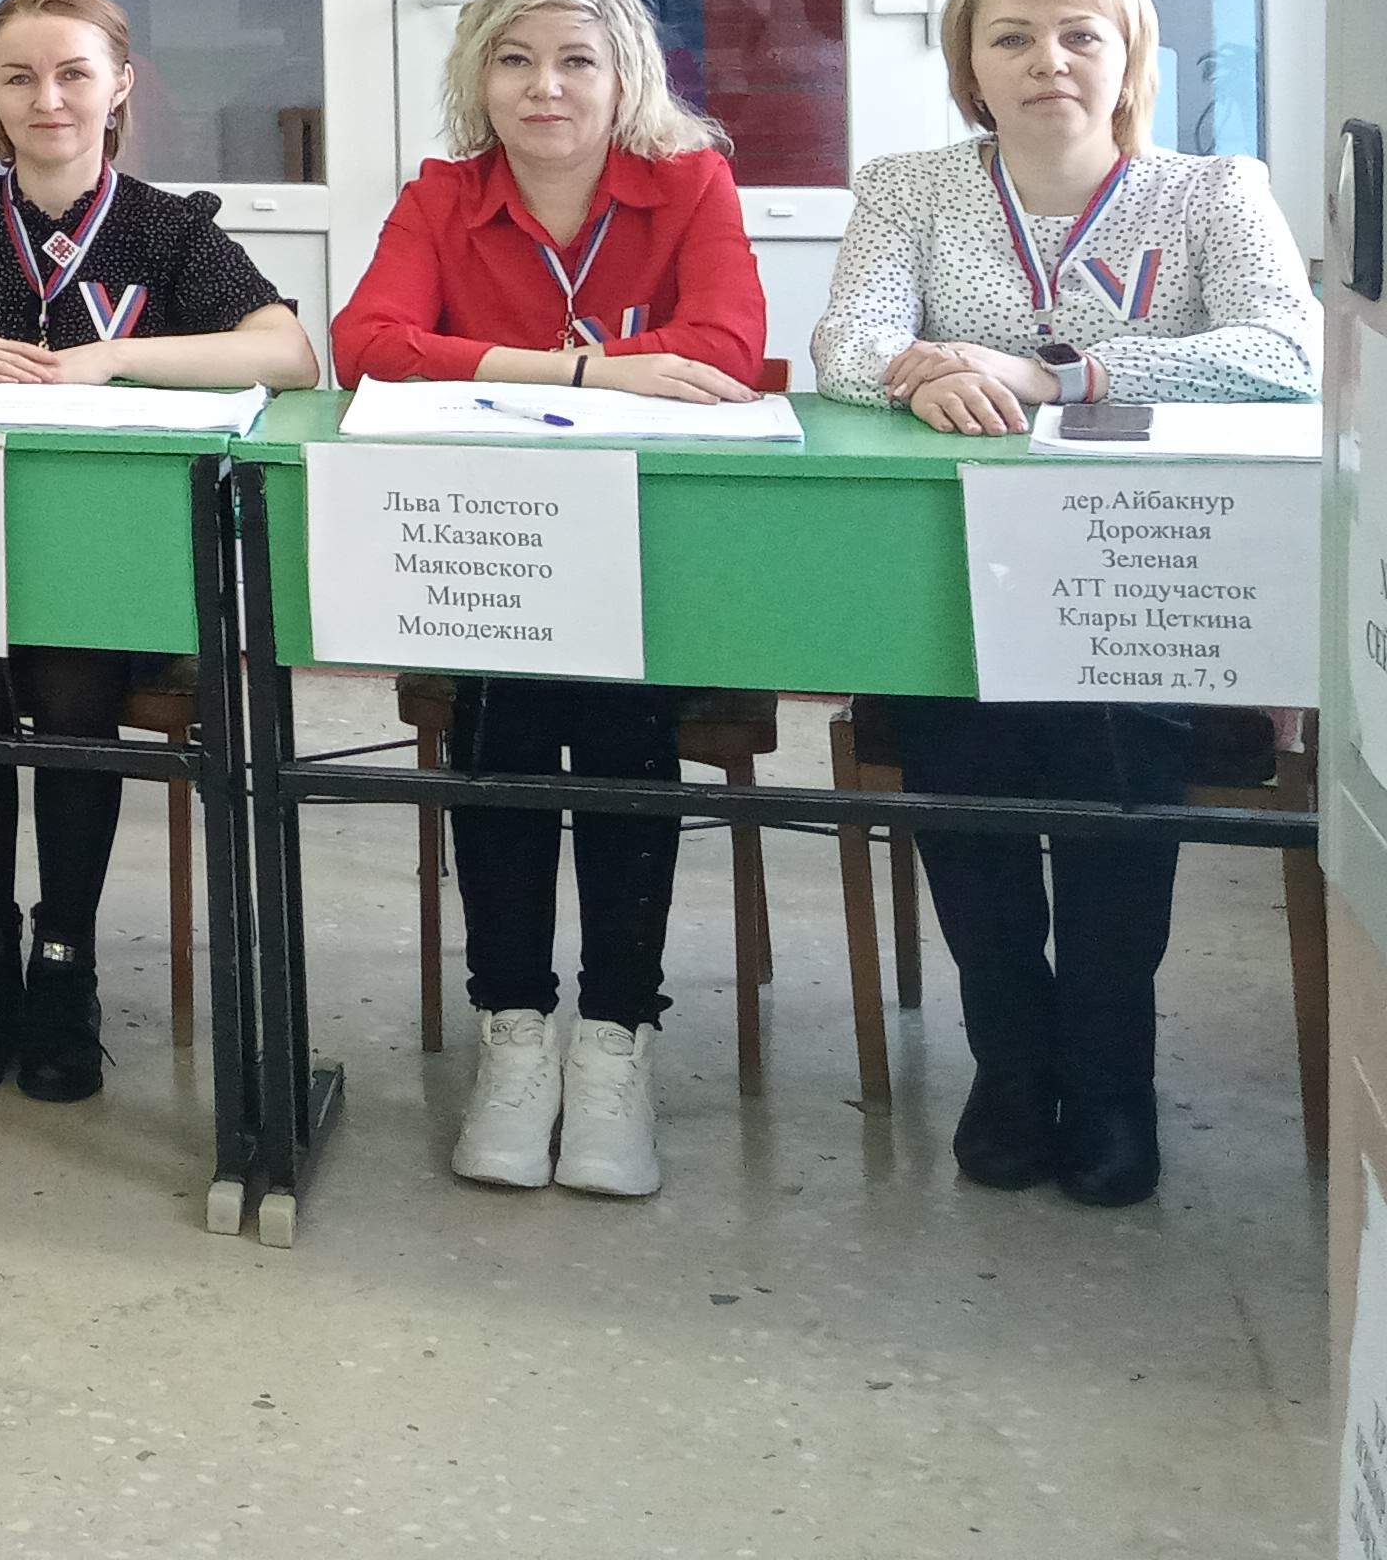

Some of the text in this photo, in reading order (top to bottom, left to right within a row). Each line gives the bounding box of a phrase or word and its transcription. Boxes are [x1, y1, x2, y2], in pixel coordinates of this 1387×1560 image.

[383, 492, 558, 516] Льва Толстого
[1062, 491, 1234, 515] дер.Айбакнур
[402, 523, 543, 547] М.Казакова
[1087, 520, 1211, 544] Дорожная
[394, 553, 552, 578] Маяковского
[1102, 549, 1197, 568] Зеленая
[426, 585, 521, 612] Мирная
[1052, 578, 1256, 602] АТТ подучасток
[397, 615, 553, 641] Молодежная
[1059, 607, 1252, 632] Клары Цеткина
[1090, 637, 1220, 658] Колхозная
[1078, 666, 1237, 690] Лесная д.7, 9
